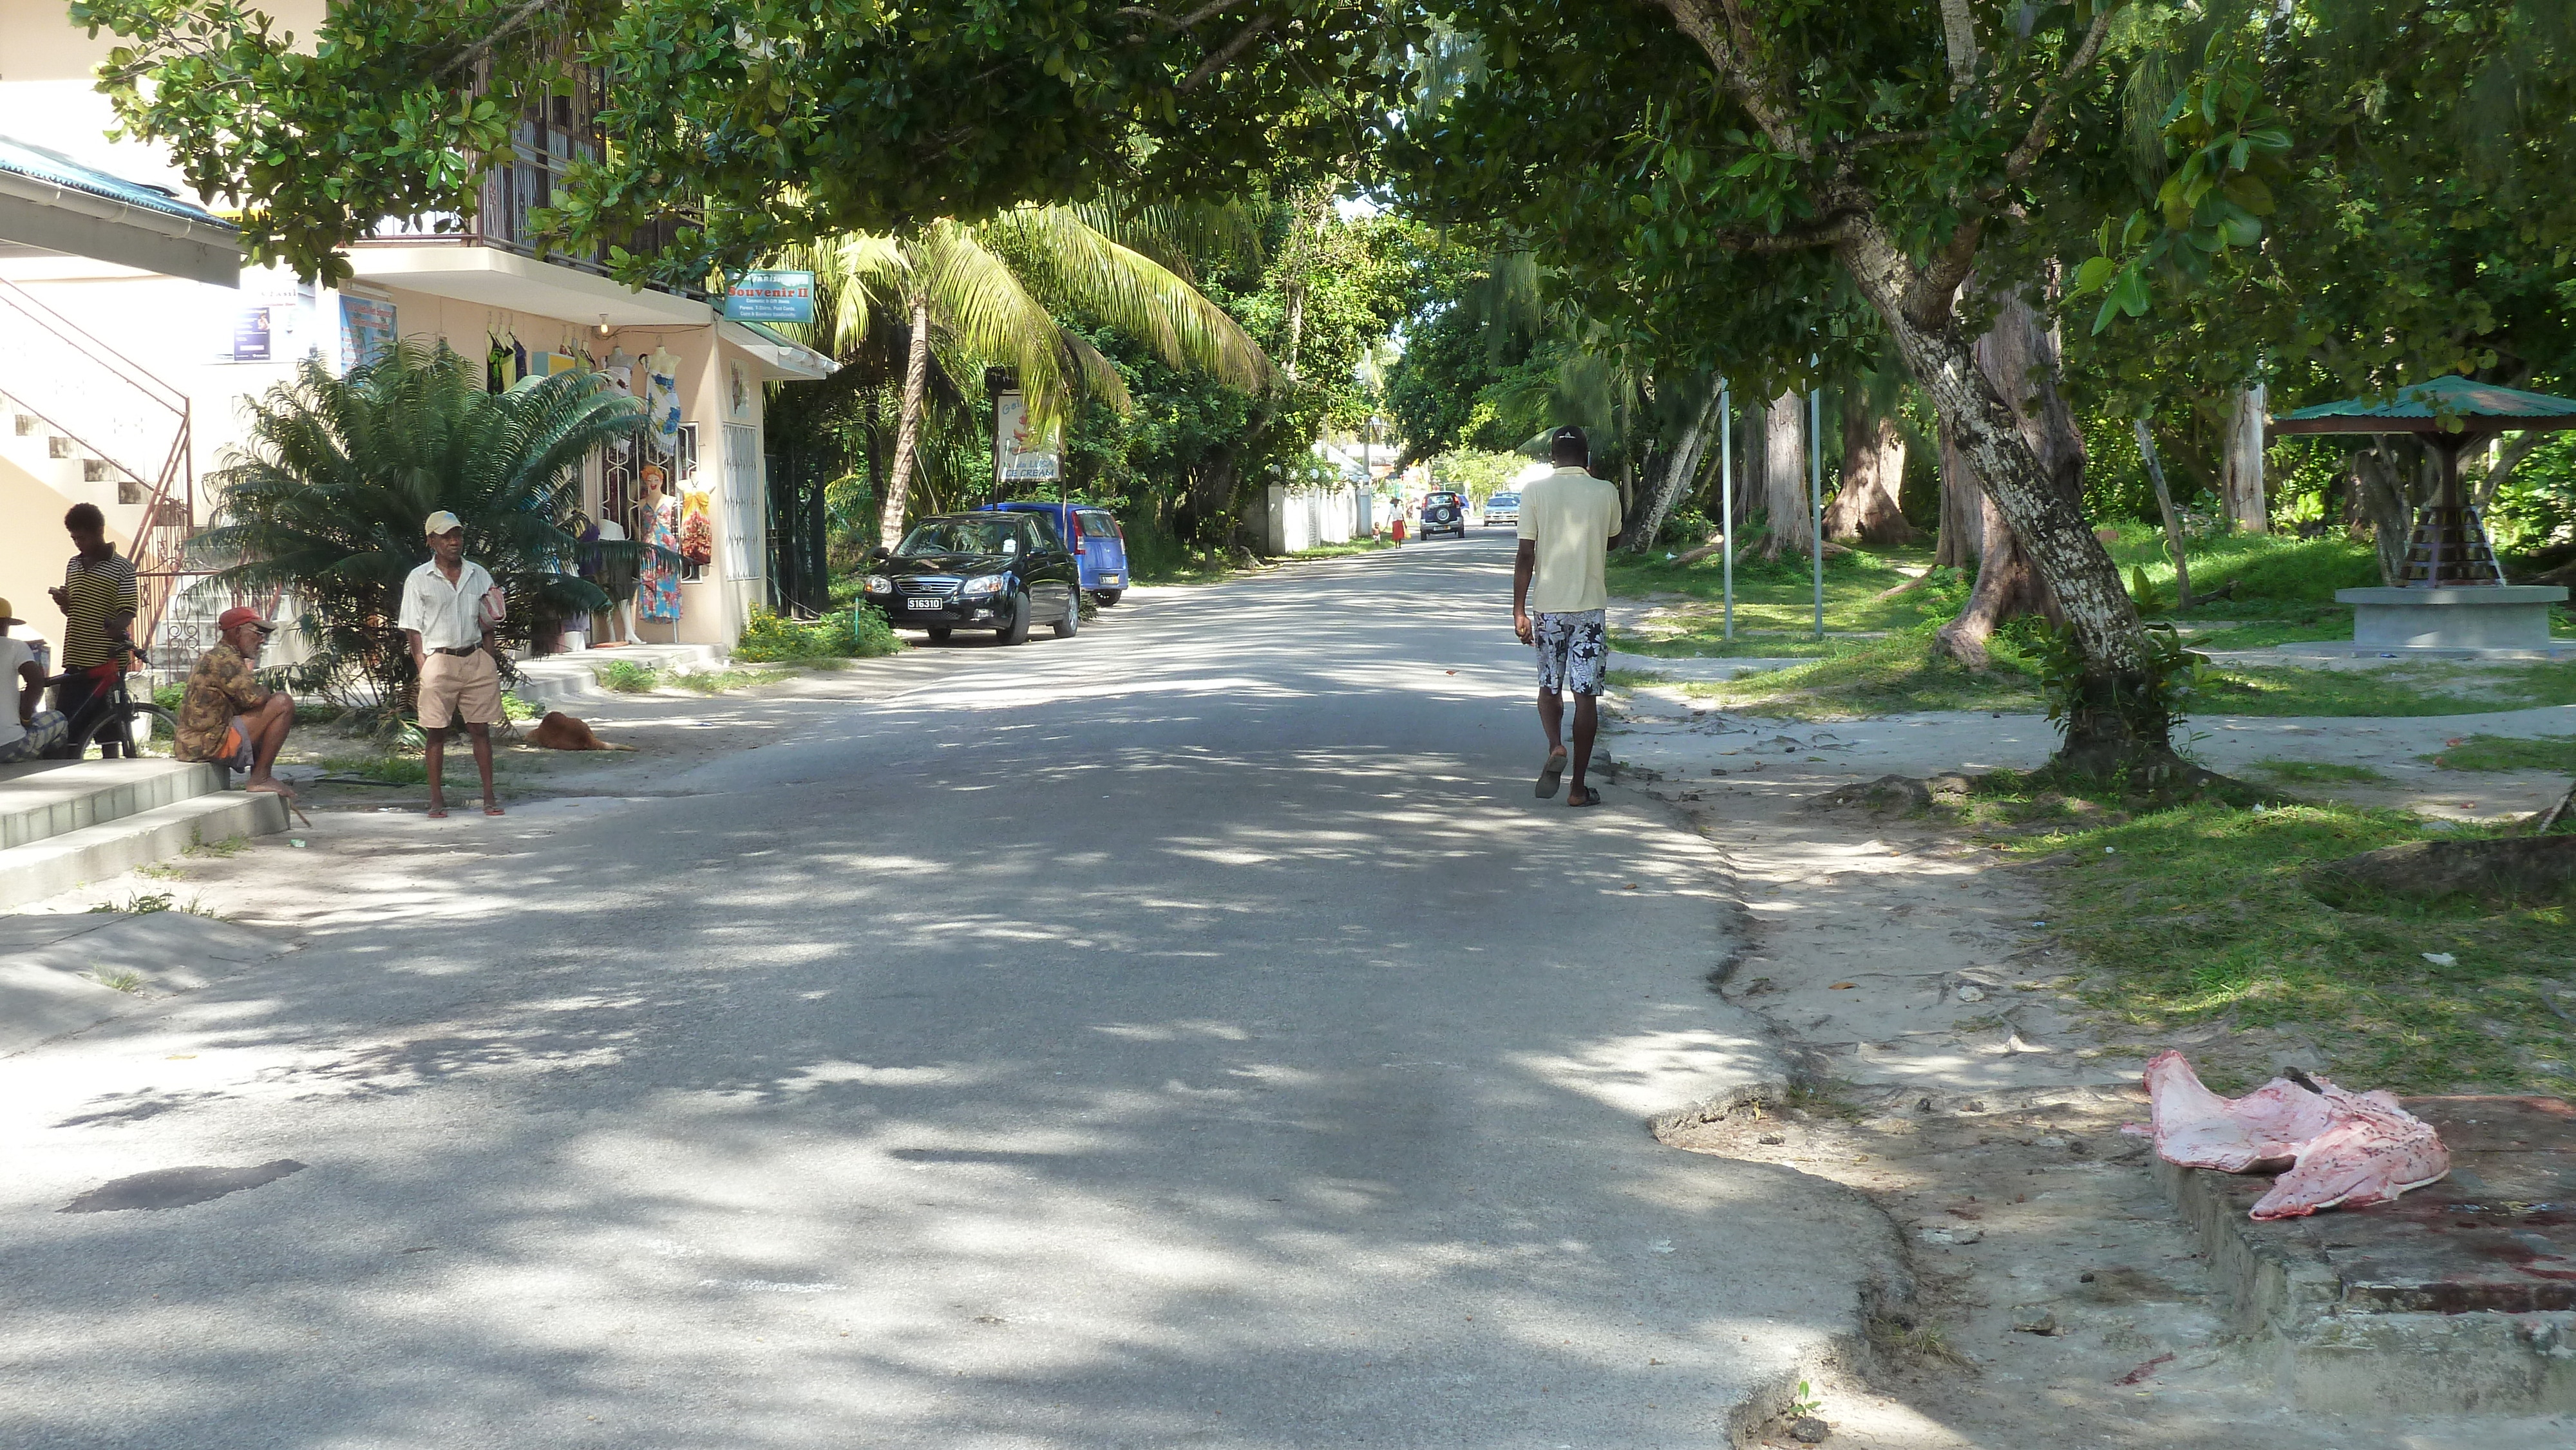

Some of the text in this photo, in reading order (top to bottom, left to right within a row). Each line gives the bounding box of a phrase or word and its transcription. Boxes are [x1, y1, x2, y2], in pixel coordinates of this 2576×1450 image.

[728, 287, 809, 298] Souvenir II
[1029, 459, 1054, 468] LUCA
[1020, 469, 1054, 477] CREAM
[909, 599, 940, 608] S16310
